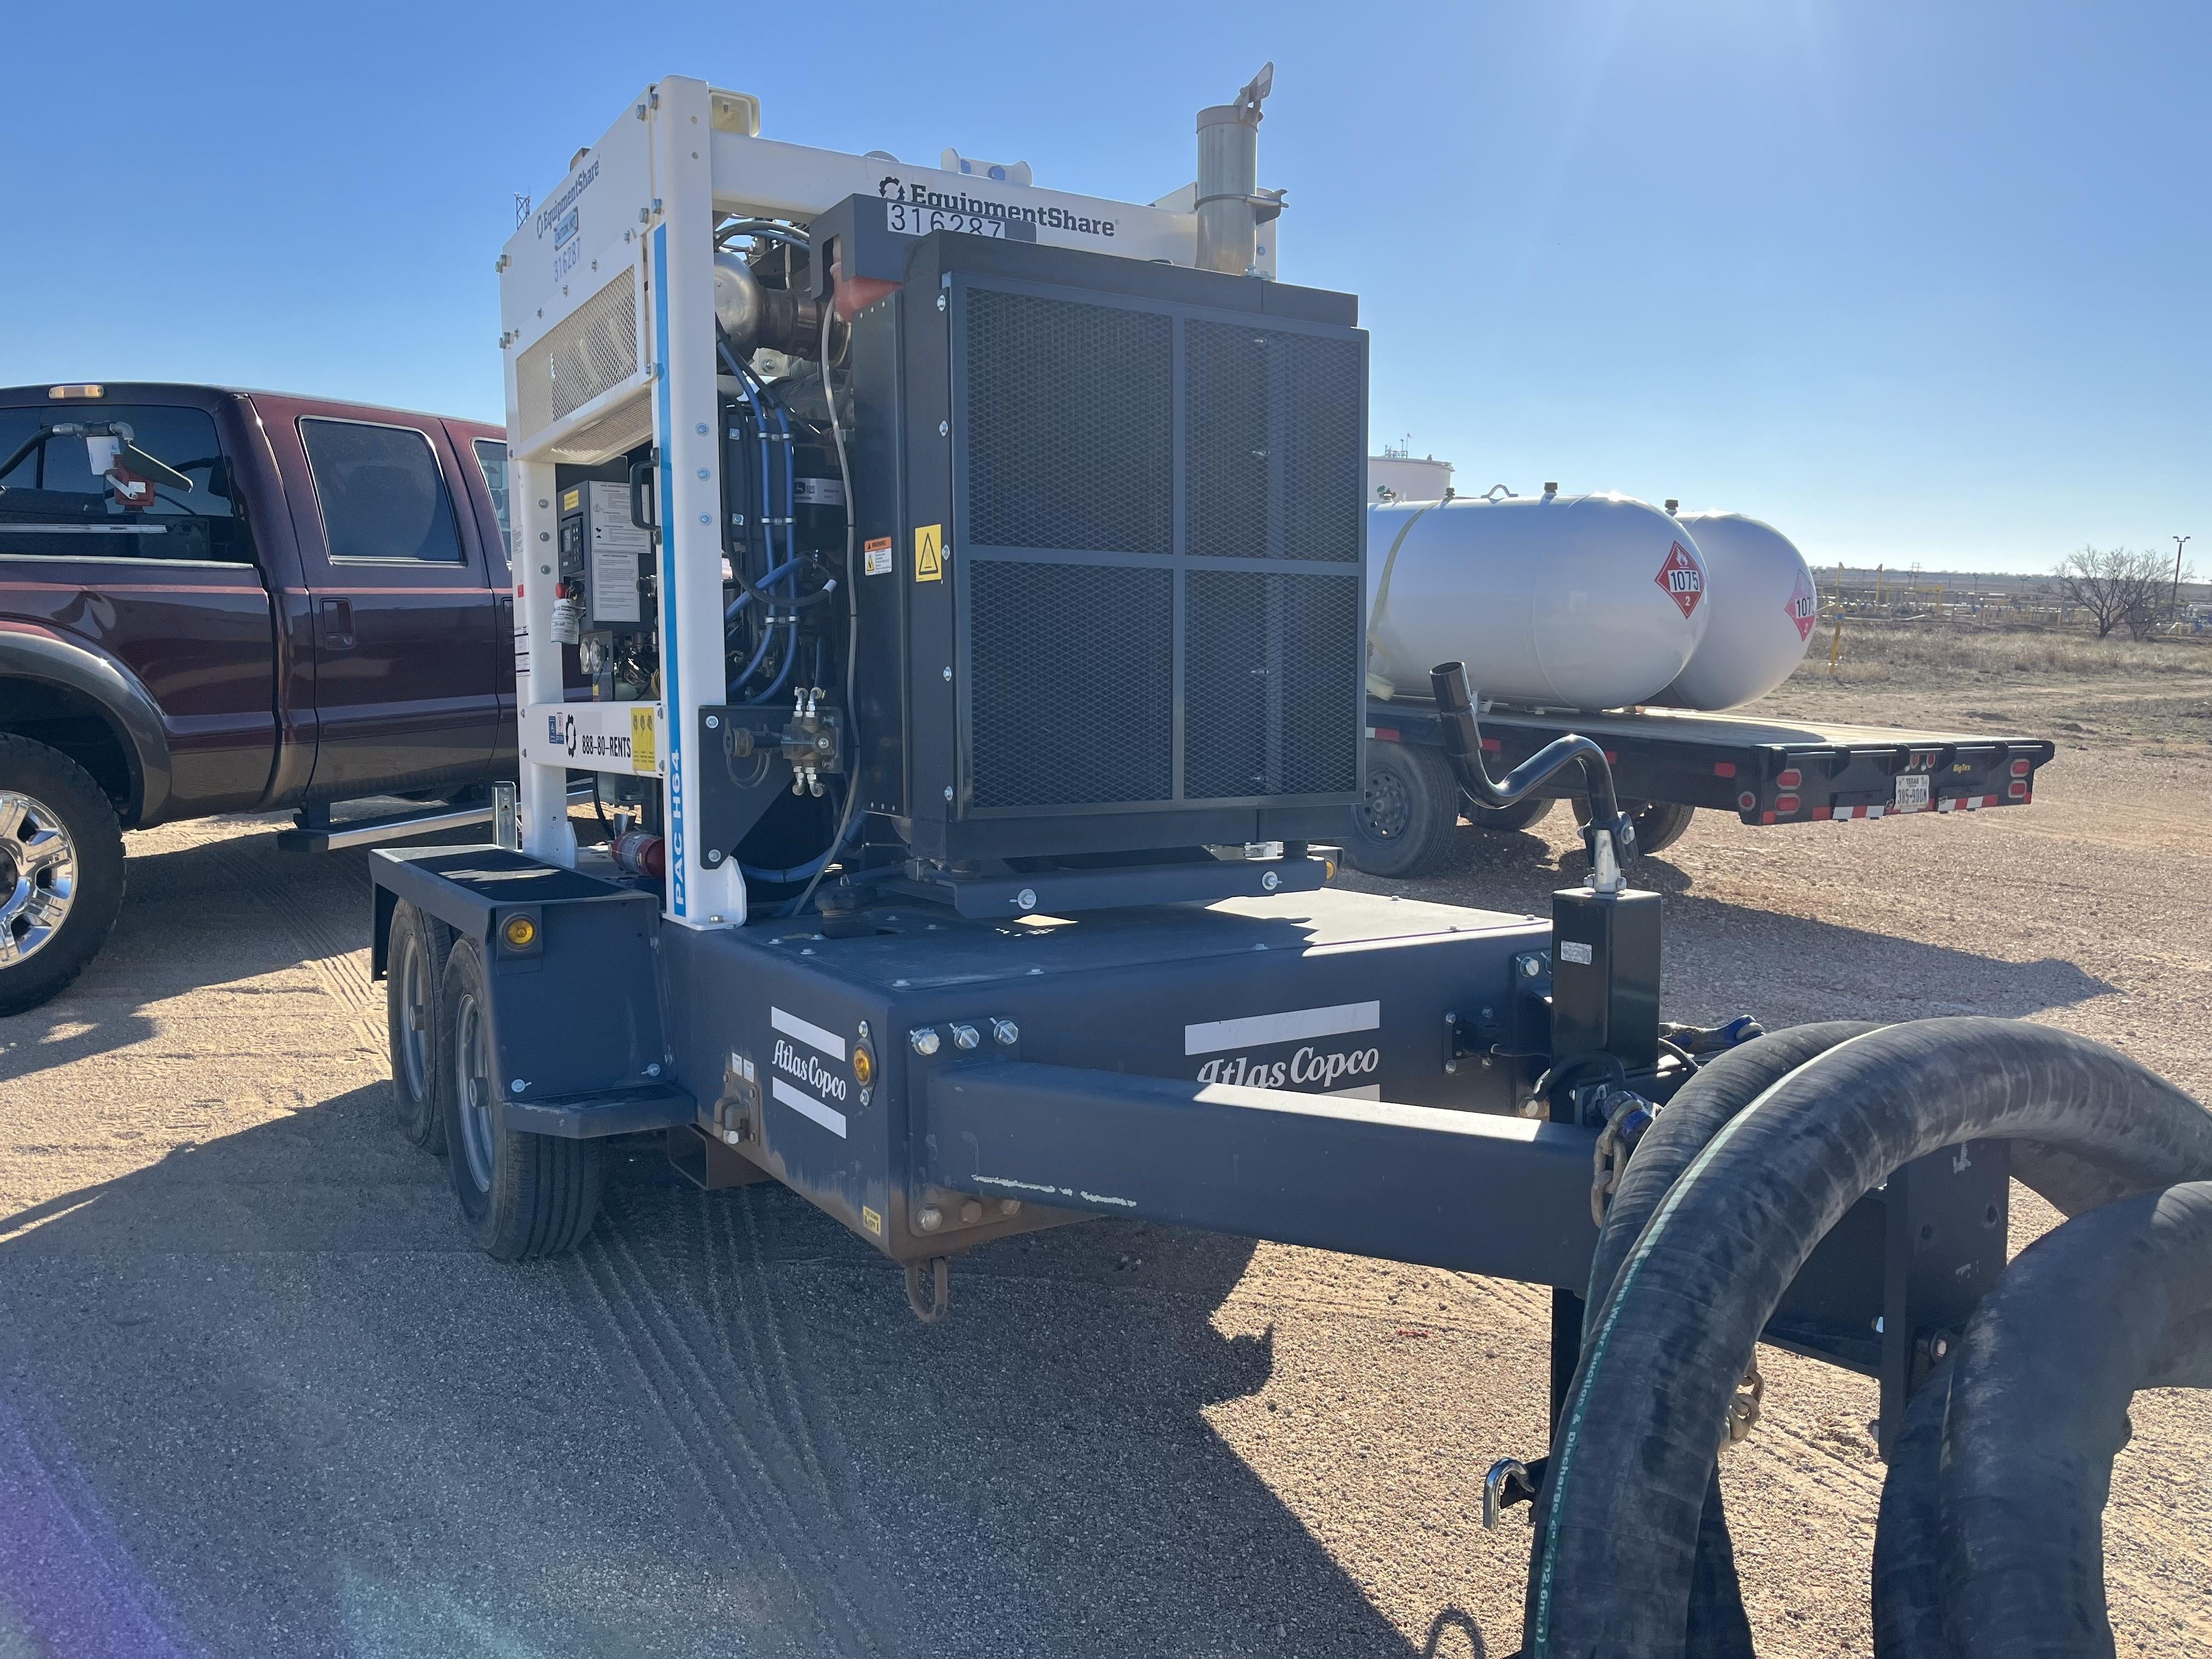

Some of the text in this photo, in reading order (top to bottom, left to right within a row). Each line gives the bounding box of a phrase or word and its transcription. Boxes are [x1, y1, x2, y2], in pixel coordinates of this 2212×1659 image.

[543, 159, 600, 230] EquipmentShare
[891, 204, 1002, 237] 316287
[554, 236, 581, 283] 316287
[1670, 571, 1699, 591] 1075
[1685, 596, 1690, 606] 2
[1803, 623, 1809, 633] 2
[582, 735, 631, 758] 888-80-RENTS
[671, 749, 685, 905] PAC H64
[771, 1039, 847, 1101] Atlas Copco
[1197, 1046, 1379, 1088] Atlas Copco
[1599, 1307, 1620, 1347] Water
[1578, 1351, 1602, 1407] Suction
[1571, 1413, 1581, 1425] &
[1551, 1431, 1577, 1514] Discharge
